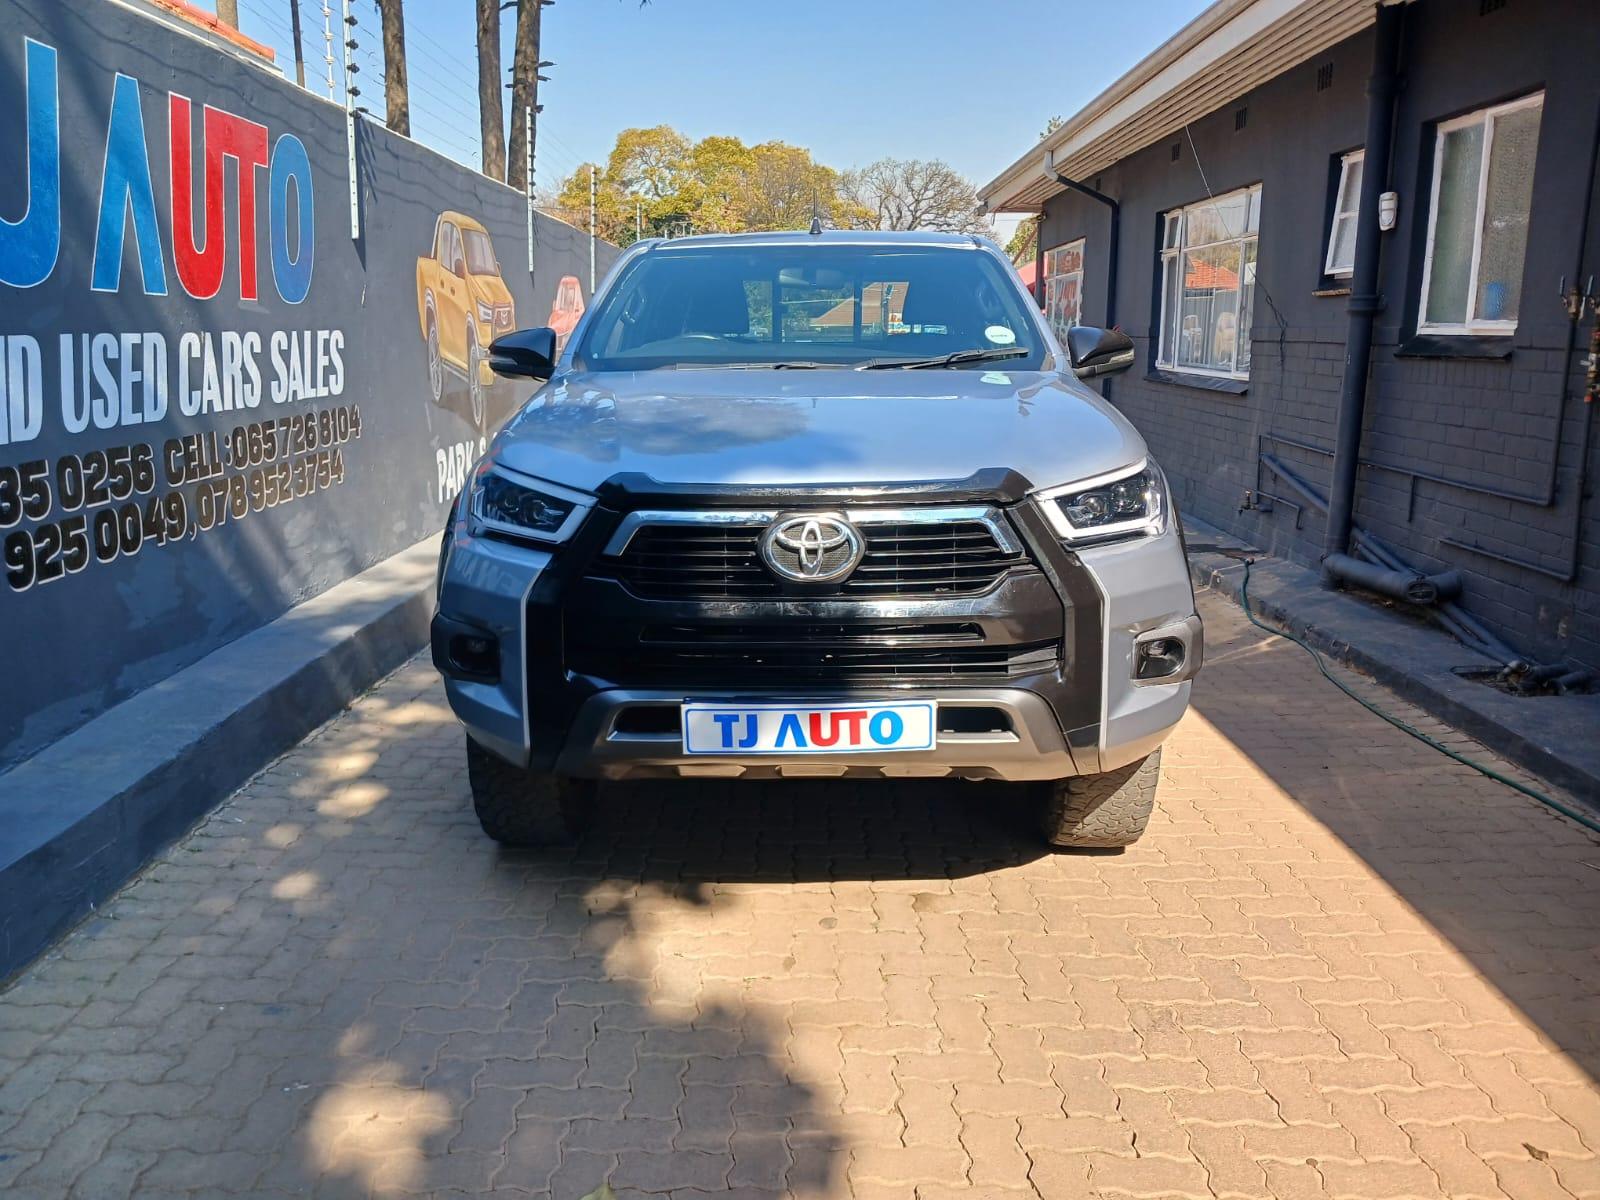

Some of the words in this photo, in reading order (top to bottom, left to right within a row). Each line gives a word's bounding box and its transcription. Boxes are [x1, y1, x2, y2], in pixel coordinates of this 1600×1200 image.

[91, 71, 314, 304] AUTO
[59, 332, 168, 434] USED
[179, 330, 261, 416] CARS
[270, 329, 345, 403] SALES
[56, 443, 156, 513] 0256
[5, 514, 90, 592] 925
[713, 713, 758, 748] TJ
[774, 710, 904, 748] AUTO
